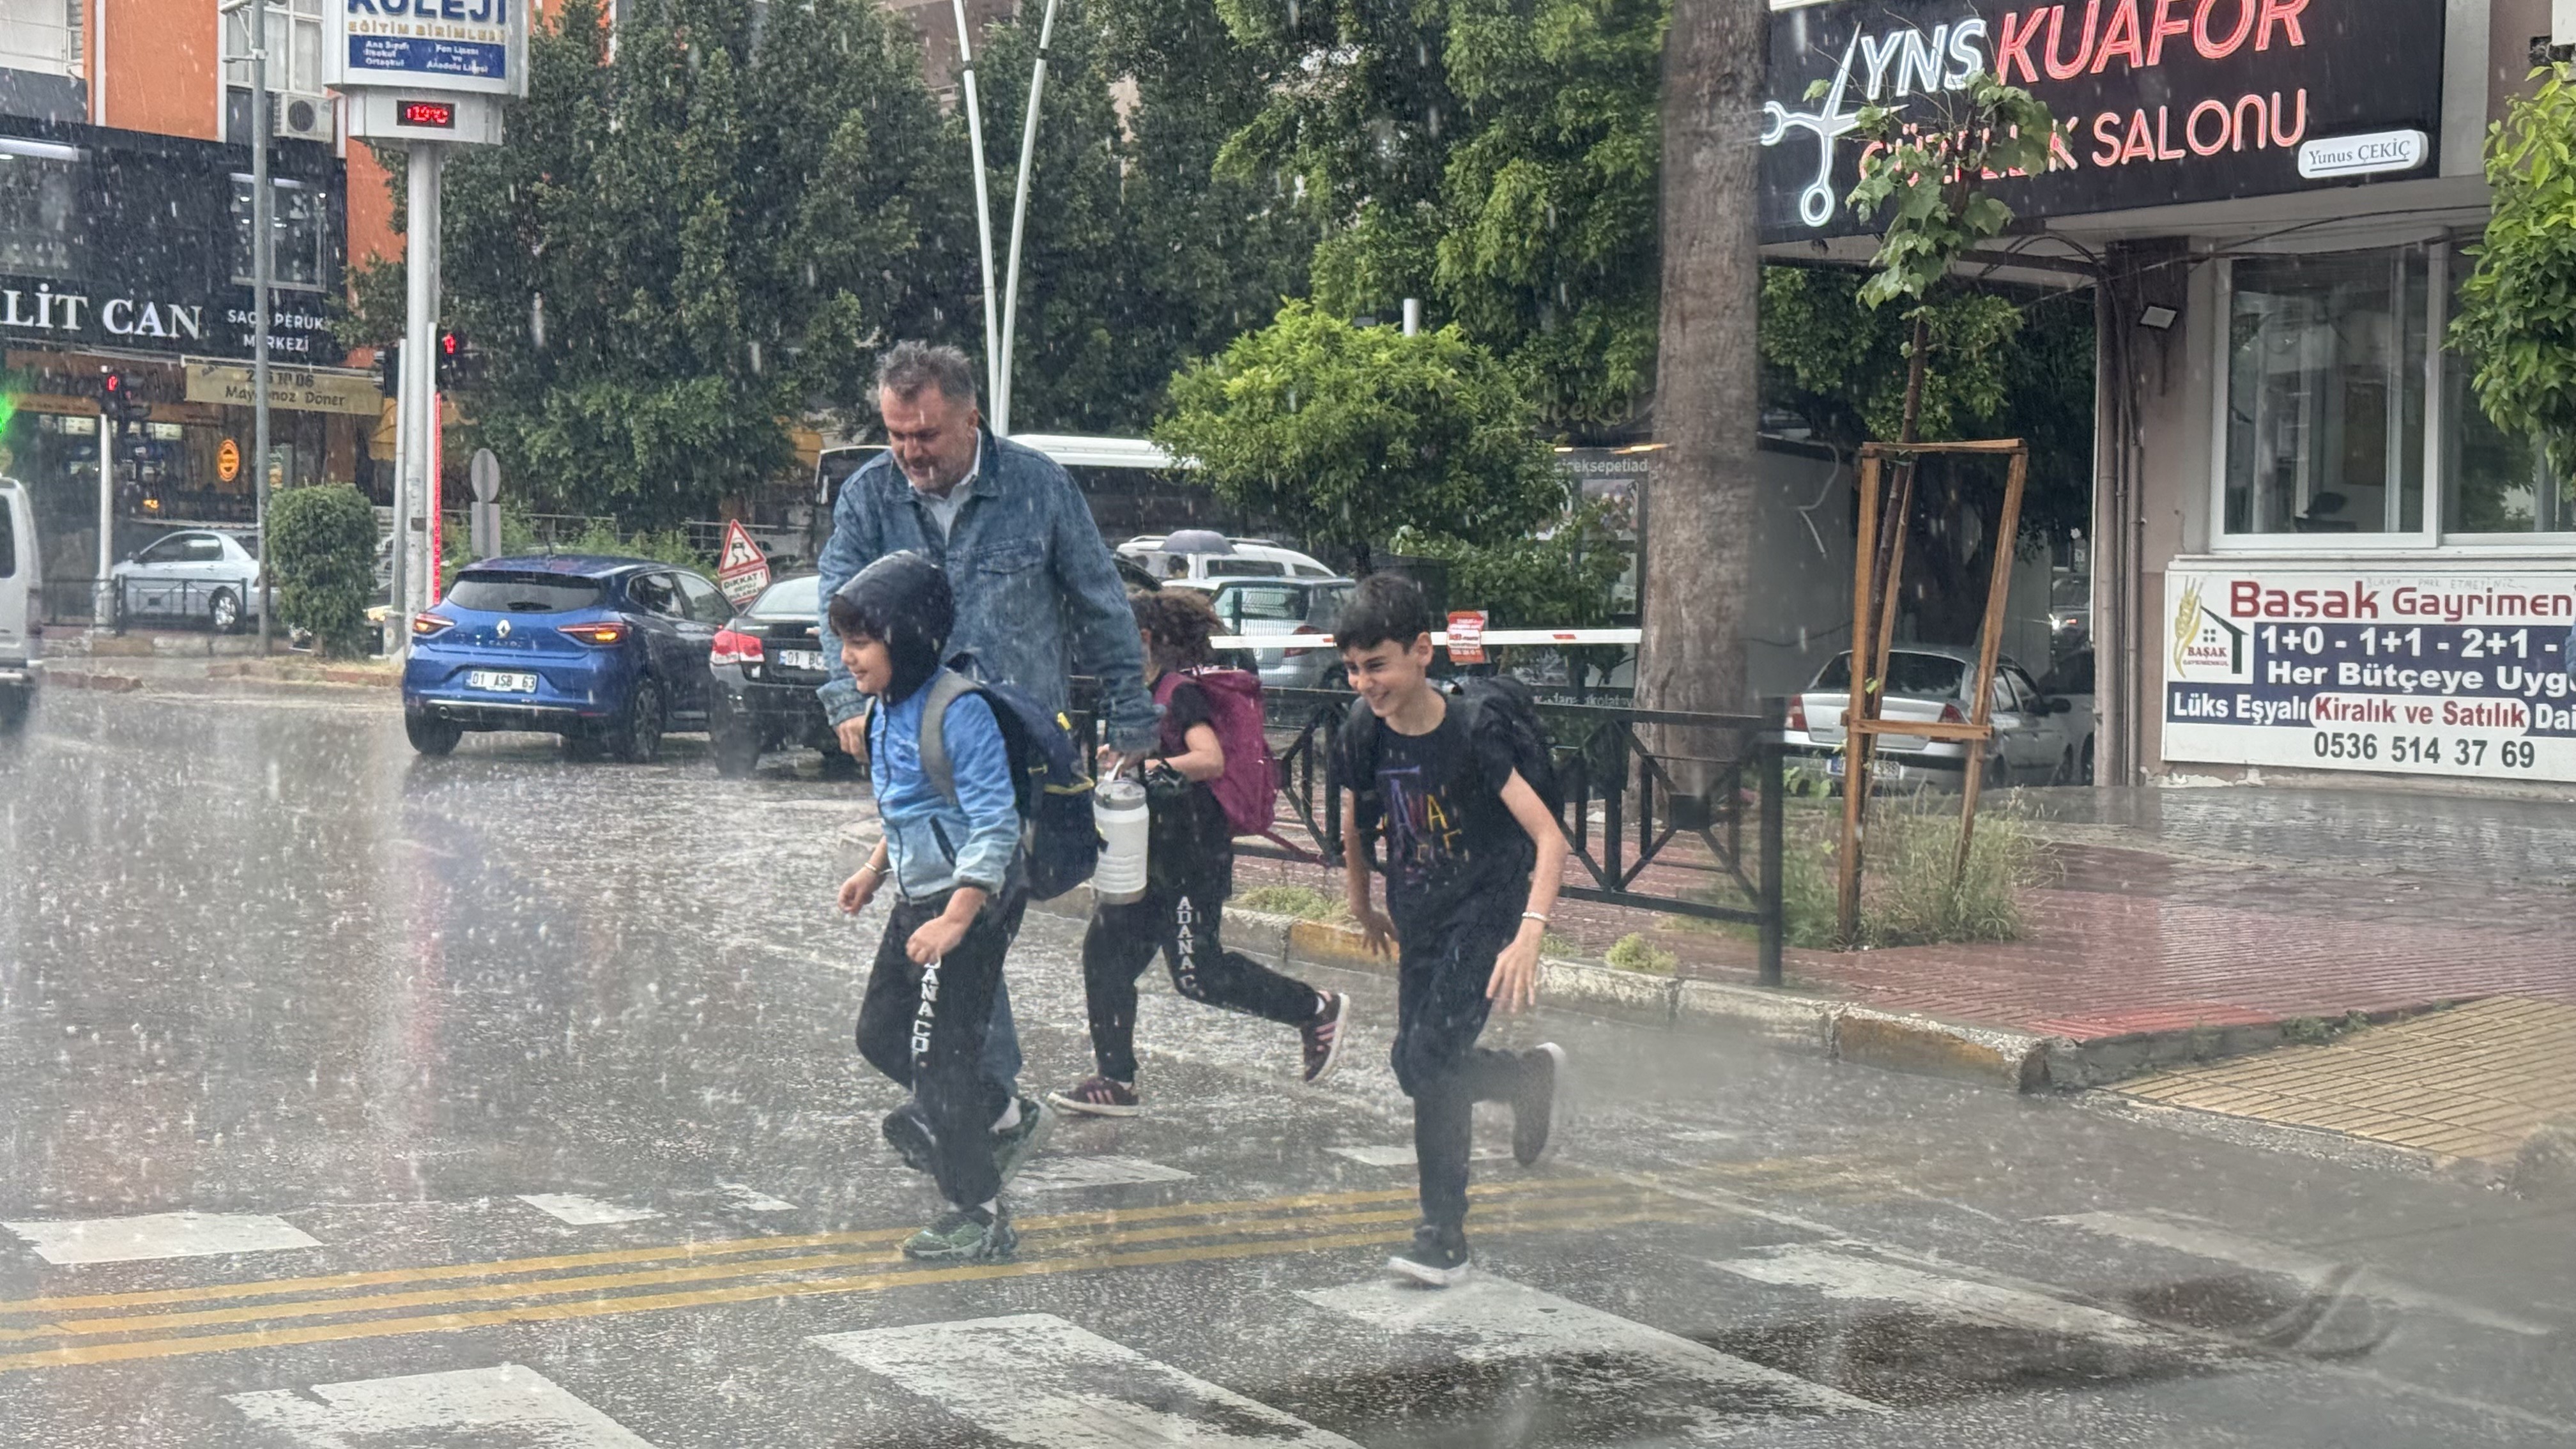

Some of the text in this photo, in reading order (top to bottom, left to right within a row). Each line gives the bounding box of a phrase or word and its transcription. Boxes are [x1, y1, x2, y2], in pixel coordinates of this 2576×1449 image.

[1860, 19, 1986, 100] YNS
[2308, 138, 2411, 165] Yunus ÇEKİÇ
[102, 299, 203, 340] CAN
[243, 334, 309, 352] MRKEZİ
[305, 391, 346, 406] Döner
[2188, 647, 2227, 659] BAŞAK
[2260, 625, 2324, 656] 1+0
[2359, 626, 2423, 657] 1+1
[2461, 628, 2528, 659] 2+1
[472, 673, 536, 689] 01 ASB 63
[2267, 661, 2576, 698] Her Bütçeye Uyg
[2174, 691, 2228, 718] Lüks
[2236, 694, 2308, 726] Eşyalı
[2315, 697, 2397, 724] Kiralık
[2405, 704, 2435, 725] ve
[2442, 700, 2526, 728] Satılık
[2314, 732, 2535, 769] 0536 514 37 69
